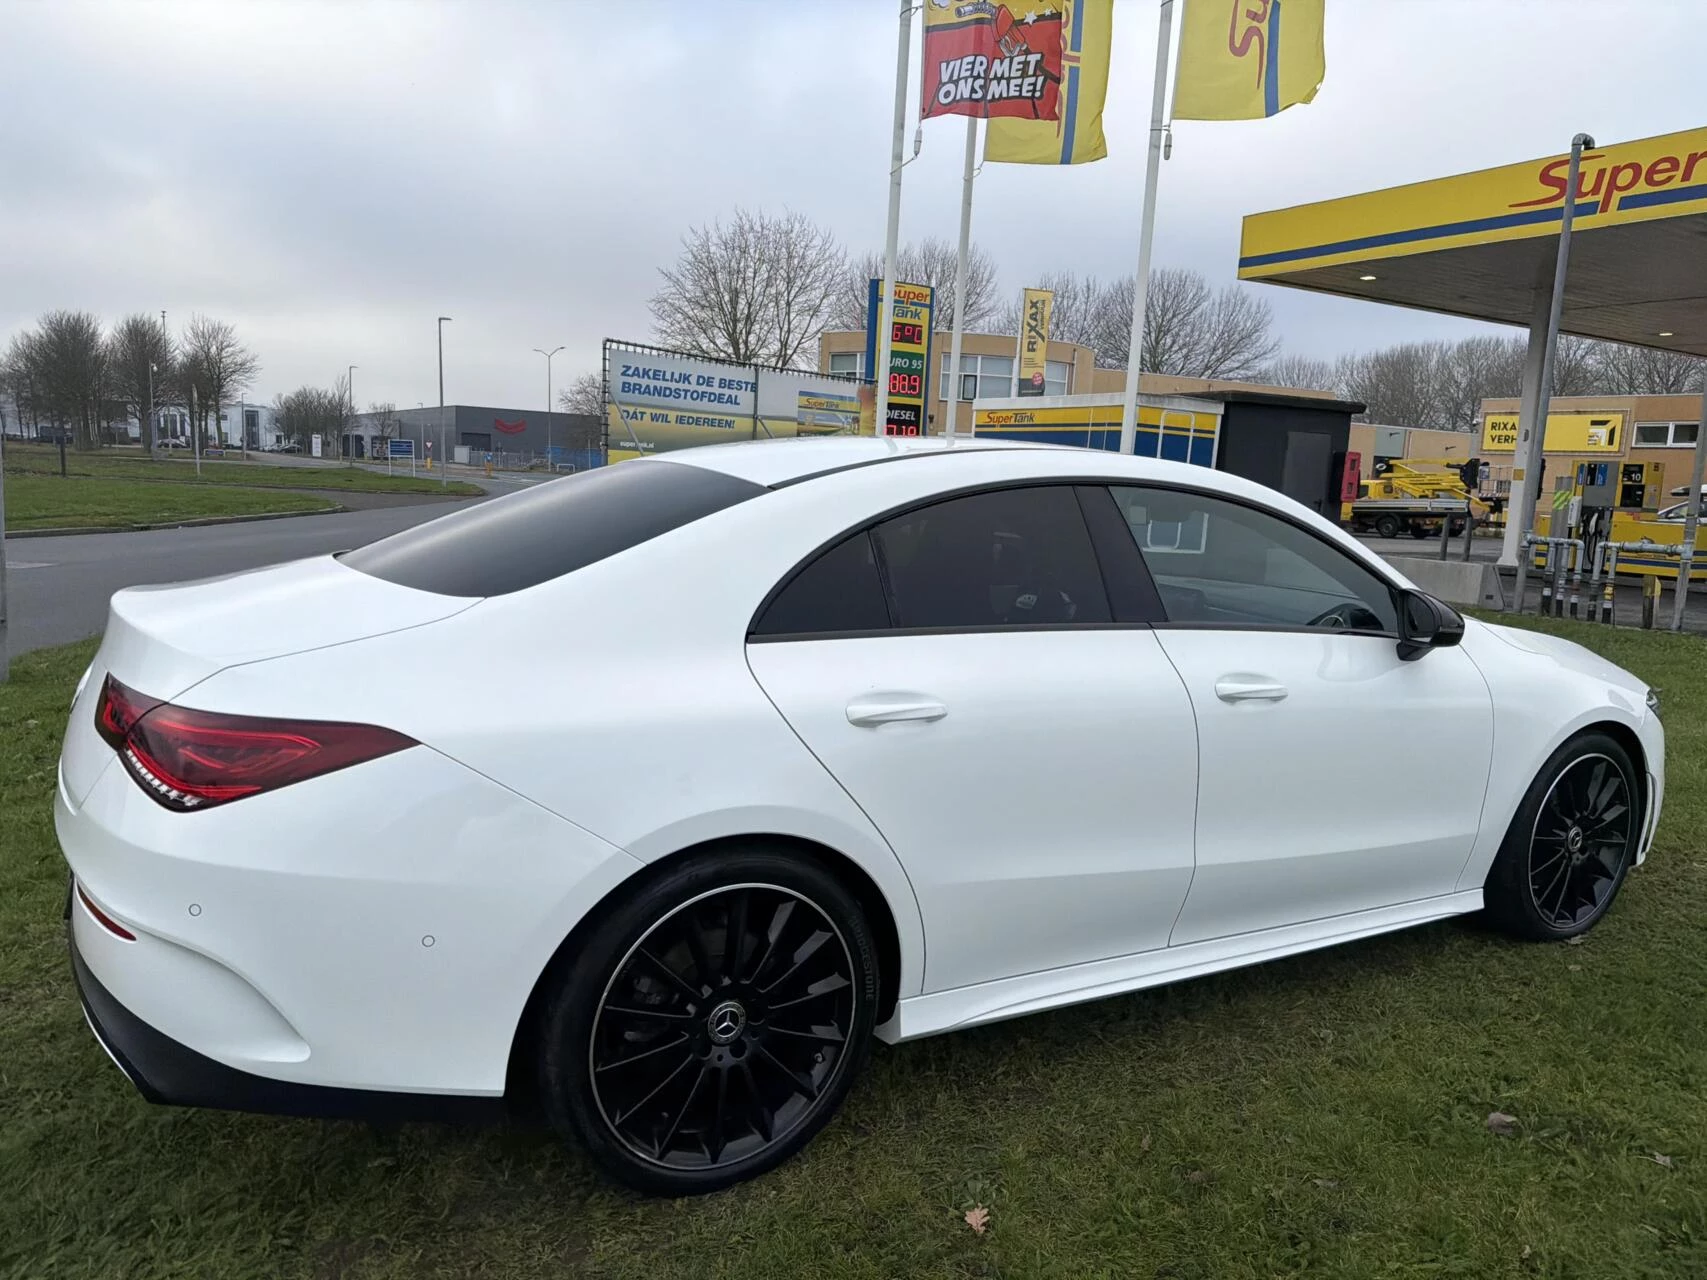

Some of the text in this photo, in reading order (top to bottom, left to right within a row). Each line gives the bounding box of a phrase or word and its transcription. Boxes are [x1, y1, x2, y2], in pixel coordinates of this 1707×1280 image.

[940, 53, 1042, 83] VIER MET
[938, 76, 1045, 105] ONS MEE!
[1508, 153, 1707, 213] Super
[1026, 299, 1046, 353] RIXAX
[889, 357, 922, 369] URO 95
[620, 364, 757, 393] ZAKELIJK DE BESTE
[889, 373, 920, 395] 88.9
[620, 381, 741, 406] BRANDSTOFDEAL
[620, 408, 735, 429] DÁT WIL IEDEREEN!
[1490, 421, 1517, 431] RIXA
[1631, 473, 1641, 481] 10
